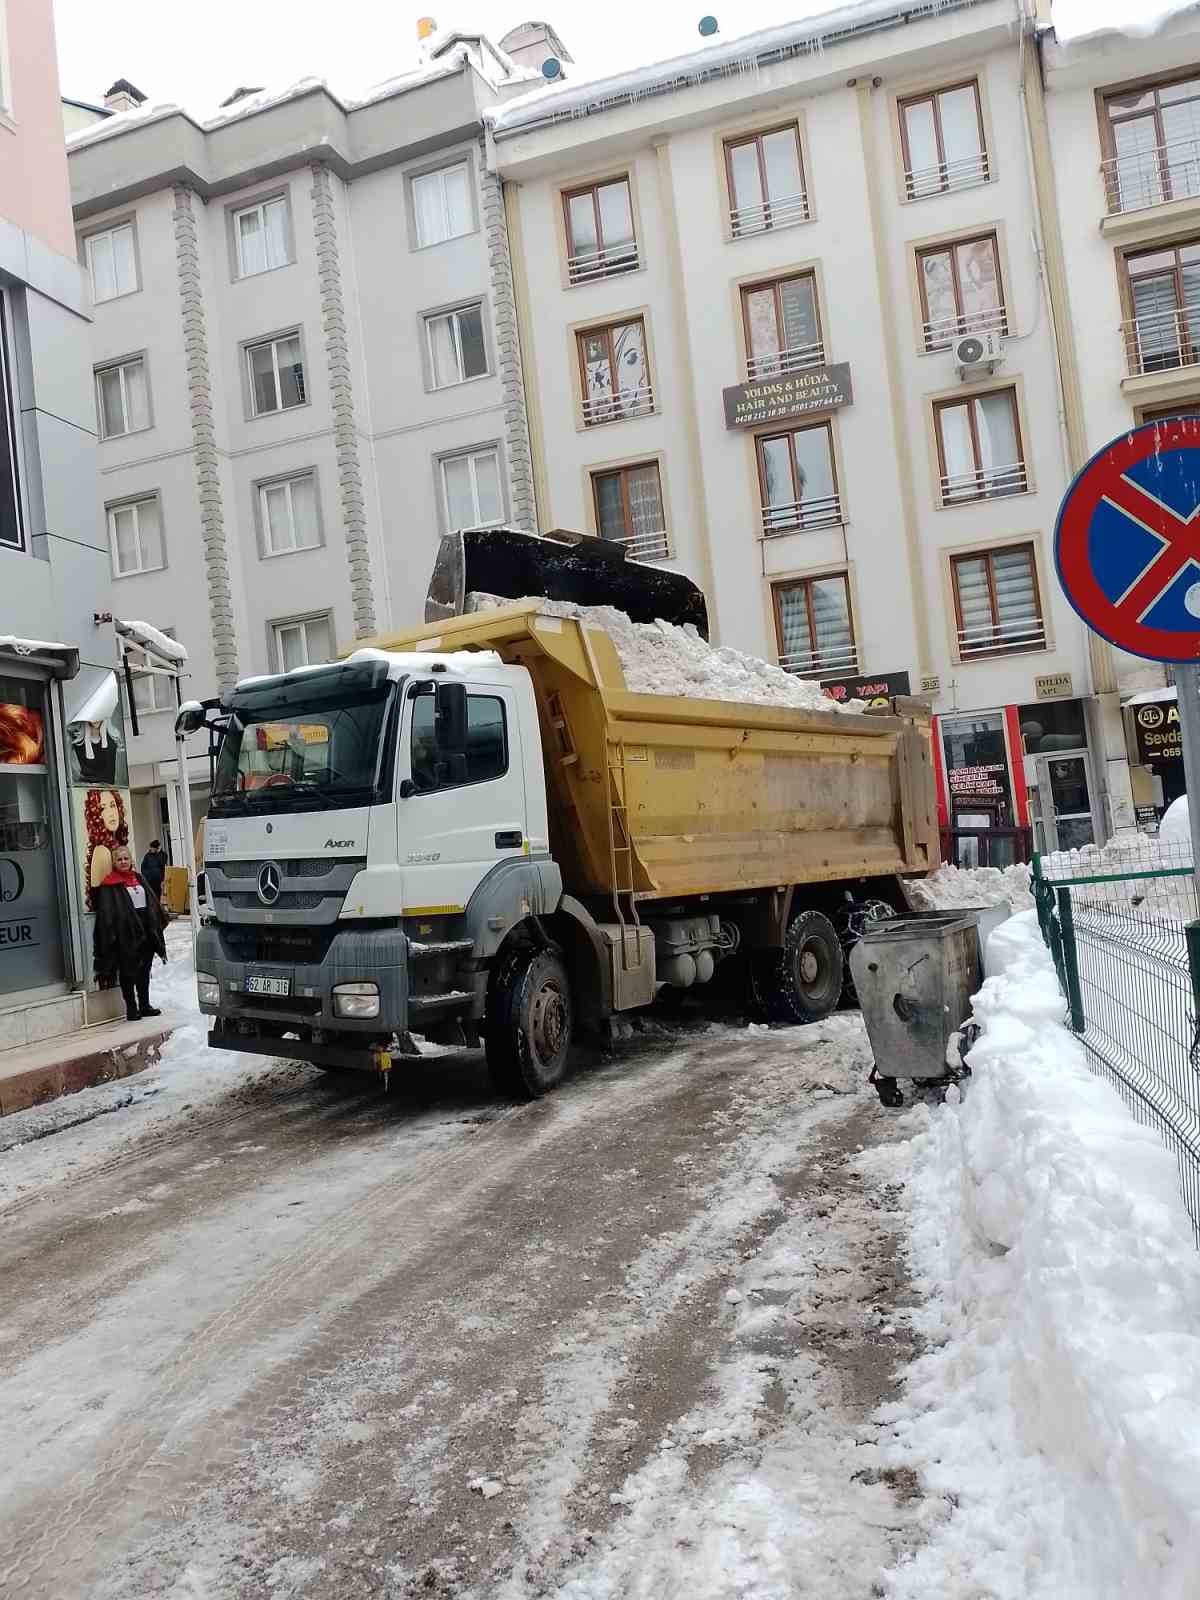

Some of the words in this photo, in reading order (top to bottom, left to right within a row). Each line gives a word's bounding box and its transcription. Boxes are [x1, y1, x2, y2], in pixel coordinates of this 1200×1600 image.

[744, 383, 783, 399] YOLDAŞ
[785, 381, 793, 392] &
[795, 373, 829, 389] HÜLYA
[768, 393, 793, 407] AND
[795, 383, 839, 400] BEAUTY
[262, 979, 272, 993] AR
